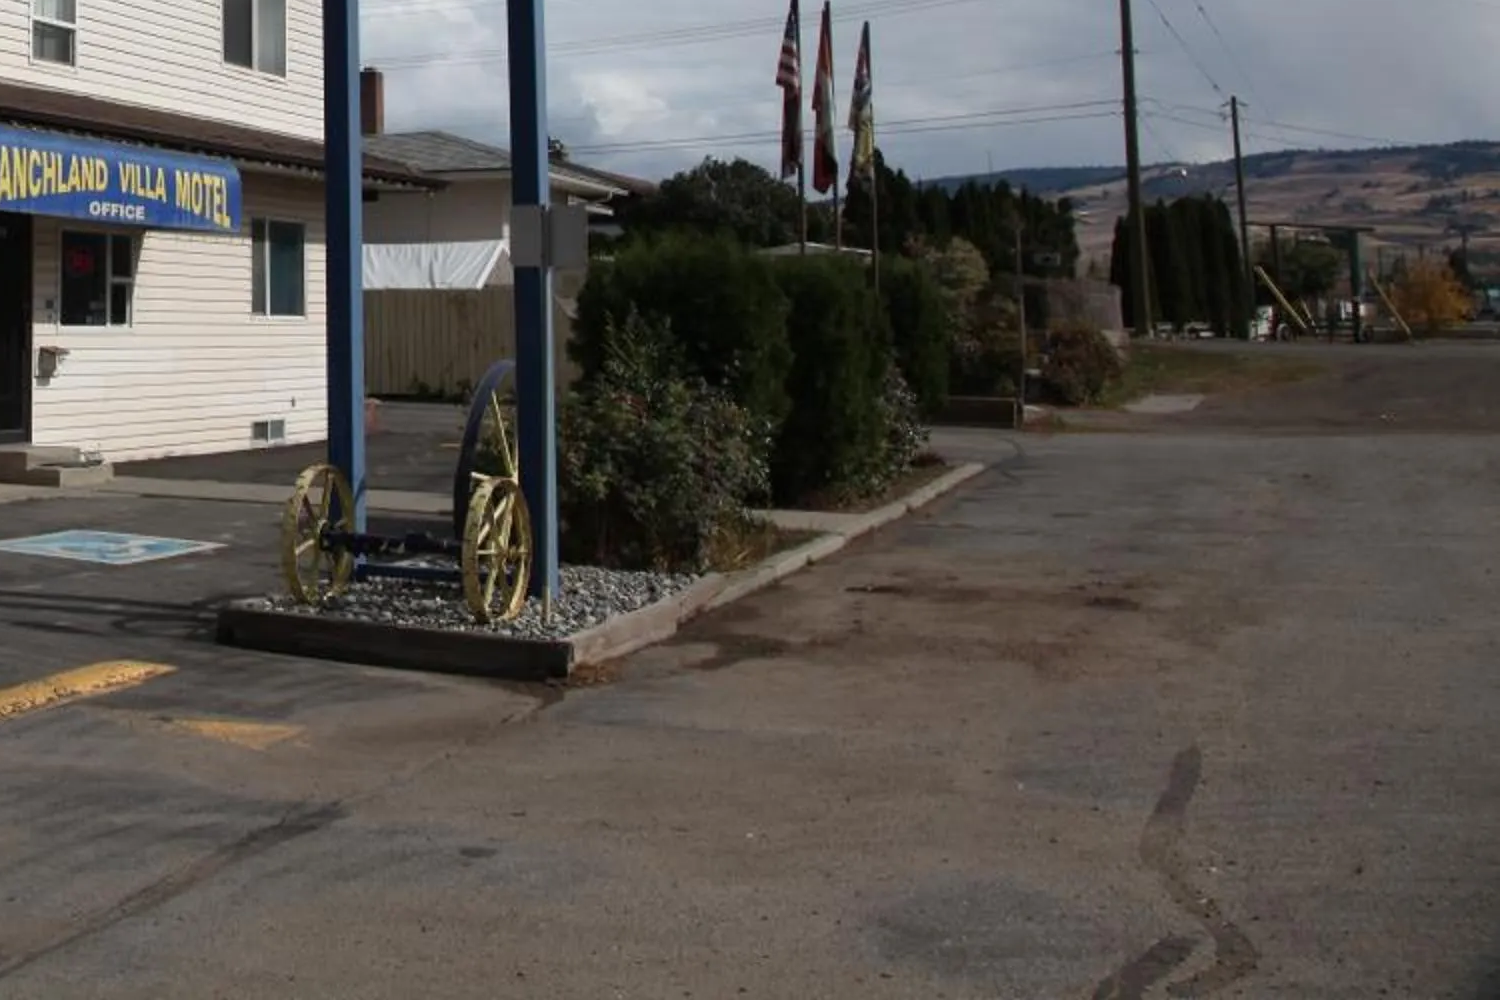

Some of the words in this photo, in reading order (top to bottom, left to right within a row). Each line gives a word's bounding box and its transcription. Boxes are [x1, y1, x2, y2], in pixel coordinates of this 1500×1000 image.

[88, 200, 145, 222] OFFICE
[118, 160, 167, 203] VILLA
[175, 169, 232, 229] MOTEL
